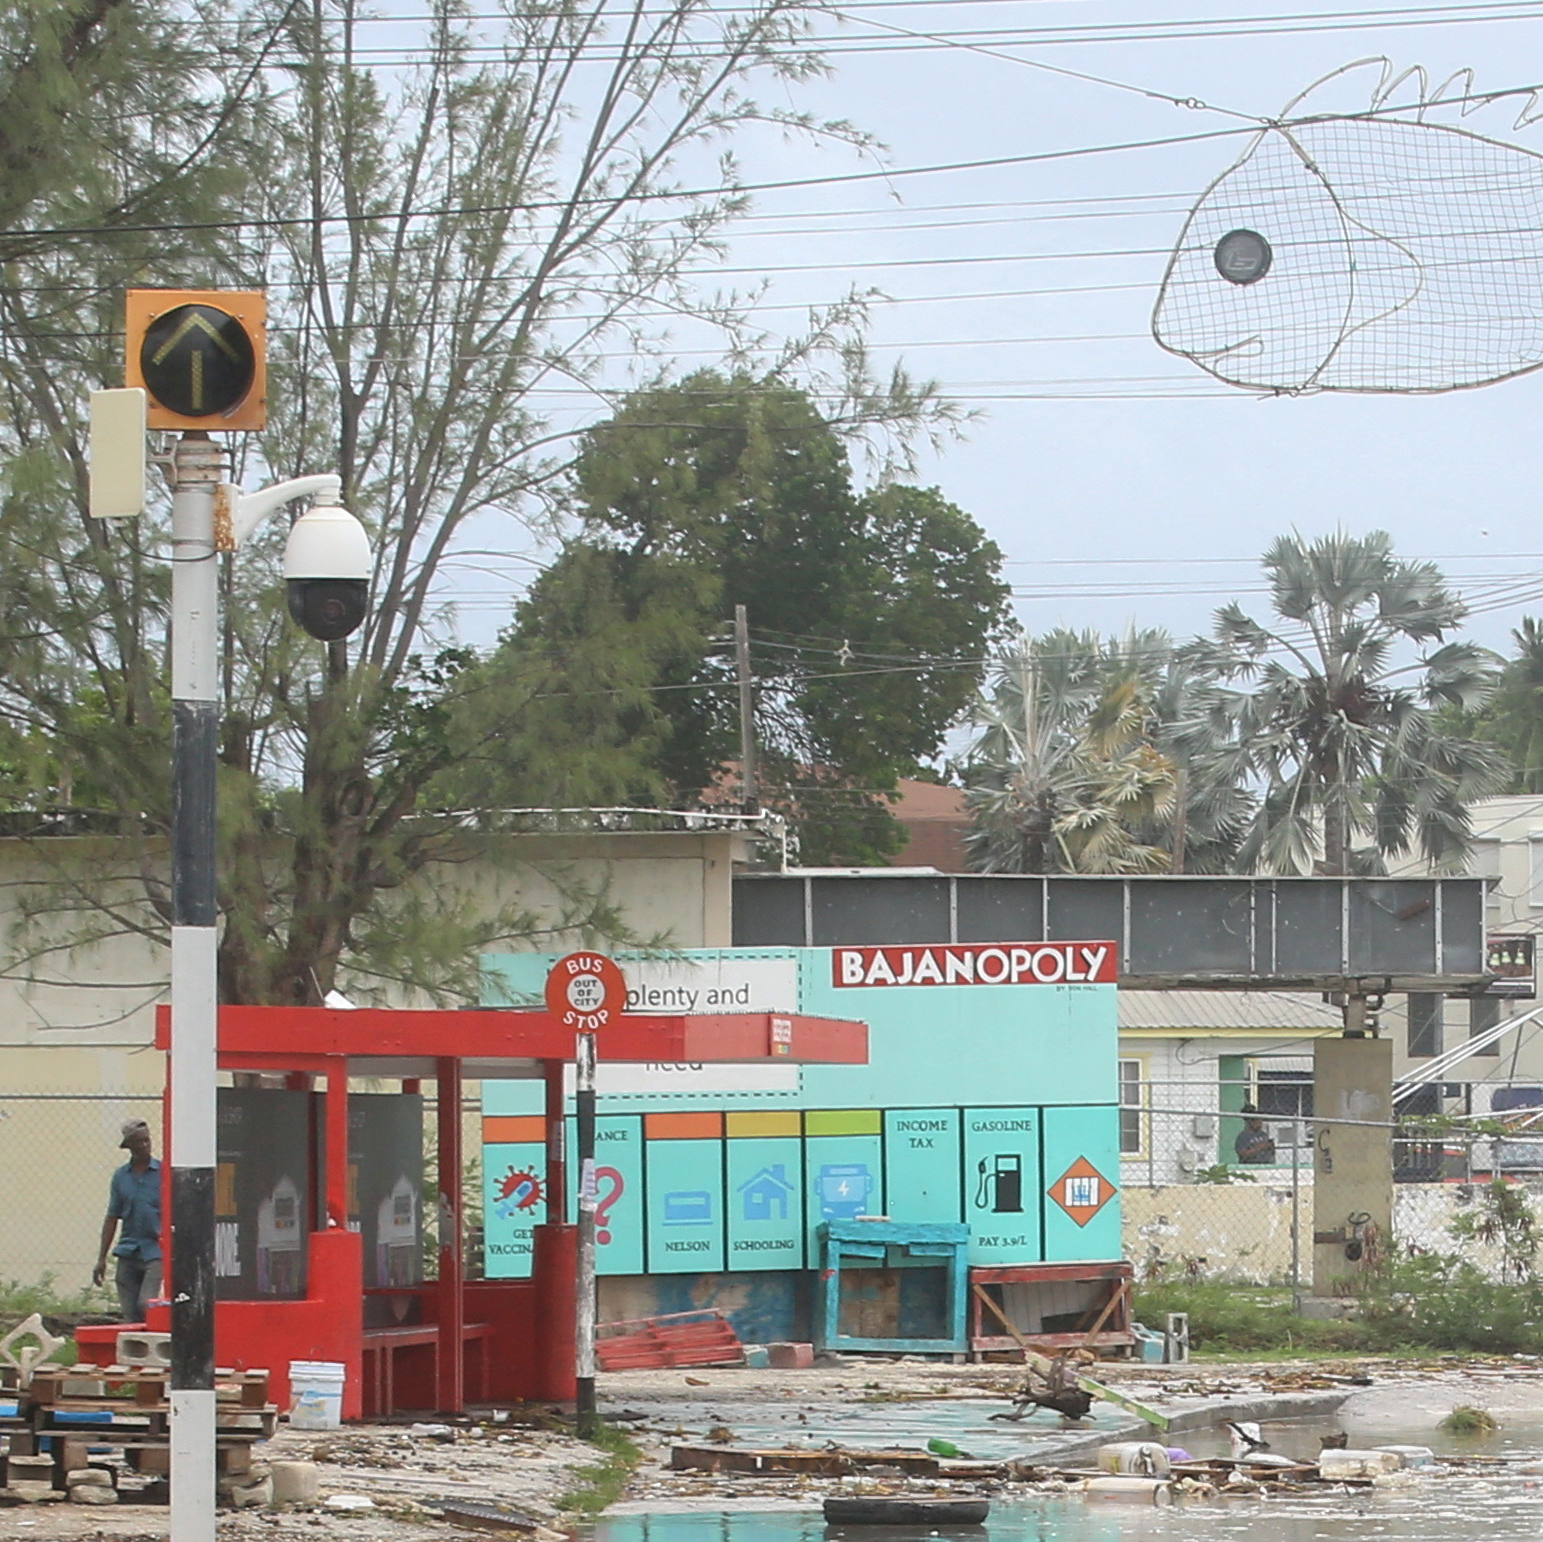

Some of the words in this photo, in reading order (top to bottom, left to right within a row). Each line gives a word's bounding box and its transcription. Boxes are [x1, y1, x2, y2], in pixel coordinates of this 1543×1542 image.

[566, 957, 604, 974] BUS
[841, 945, 1108, 984] BAJANOPOLY
[574, 980, 598, 988] OUT
[574, 998, 599, 1006] CITY
[626, 984, 699, 1009] plenty
[706, 983, 750, 1005] and
[563, 1009, 609, 1029] STOP
[897, 1120, 948, 1132] INCOME
[972, 1120, 1032, 1132] GASOLINE
[595, 1130, 629, 1142] ANCE
[909, 1138, 934, 1149] TAX
[665, 1240, 710, 1251] NELSON
[734, 1239, 795, 1251] SCHOOLING
[978, 1236, 999, 1247] PAY
[489, 1244, 534, 1255] VACCIN
